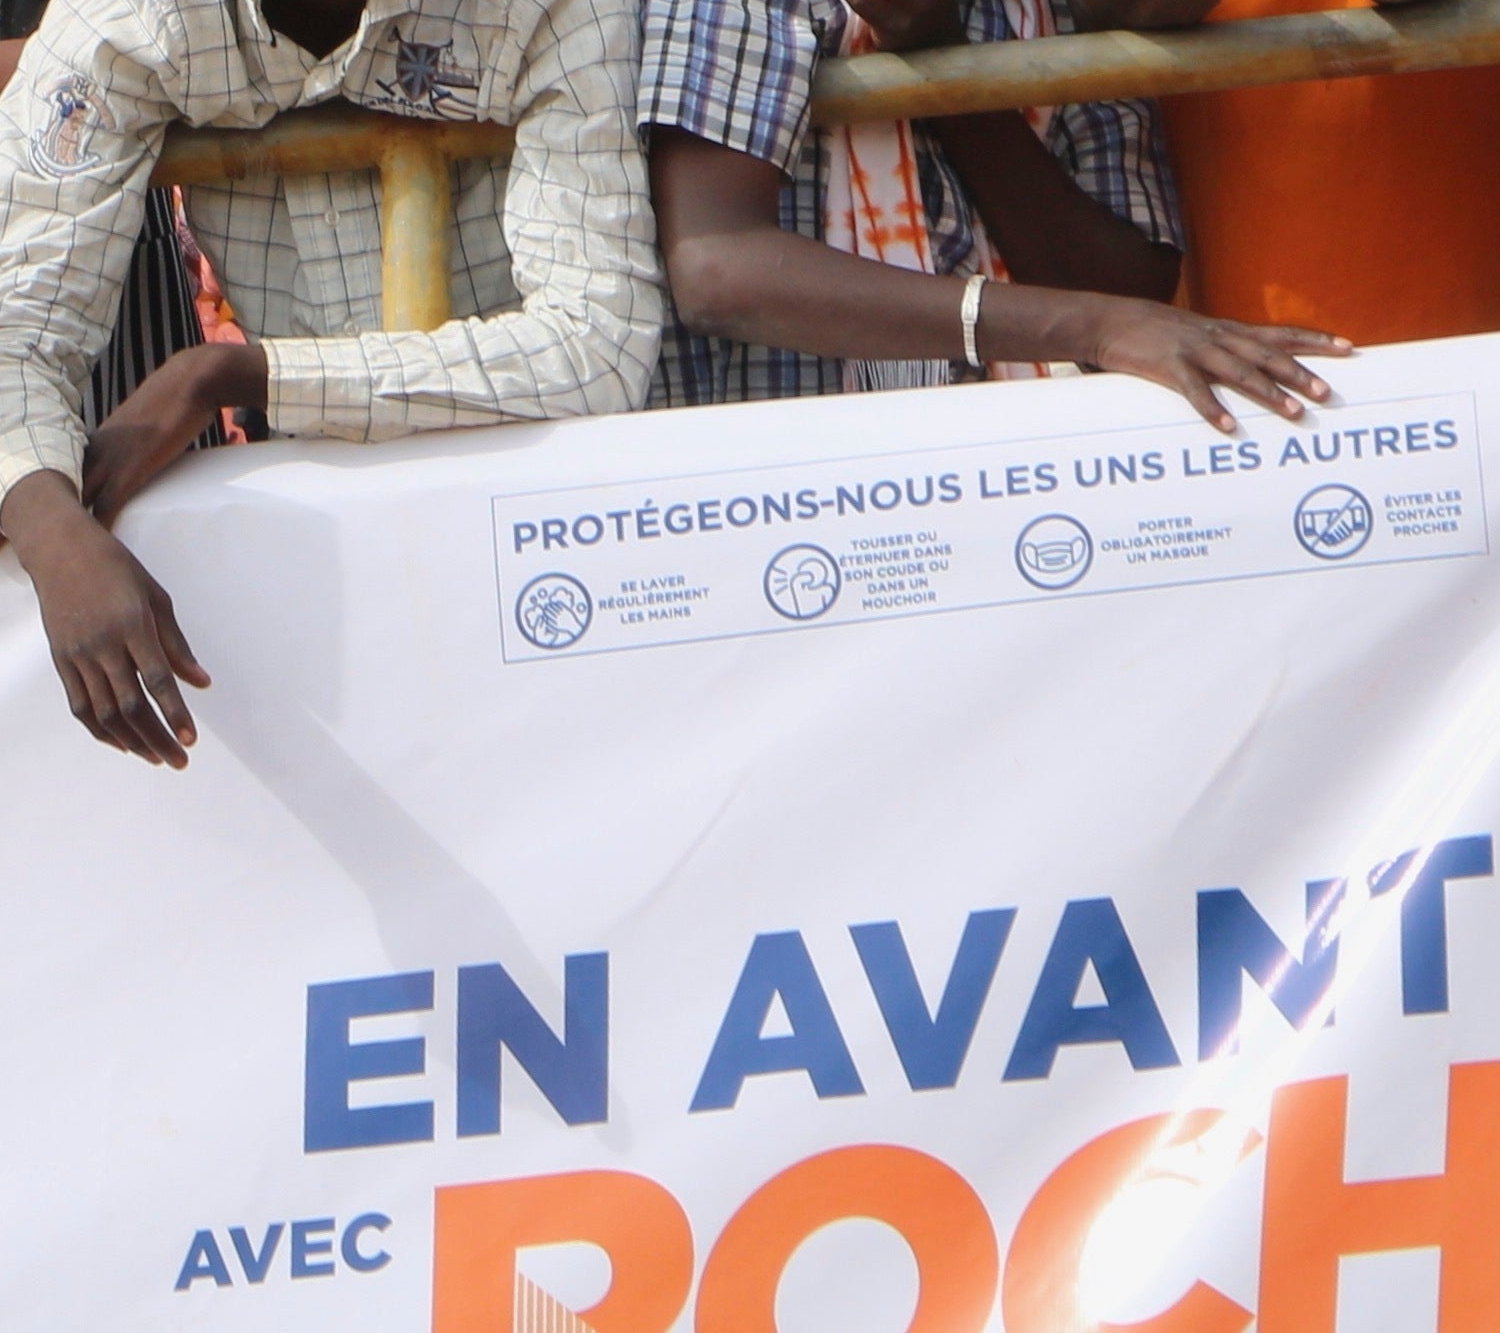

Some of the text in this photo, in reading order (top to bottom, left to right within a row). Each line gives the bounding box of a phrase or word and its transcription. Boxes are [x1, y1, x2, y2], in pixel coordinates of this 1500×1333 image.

[511, 418, 1460, 554] PROTÉGEONS-NOUS LES UNS LES AUTRES
[1383, 489, 1463, 509] ÉVITER LES
[1386, 504, 1463, 523] CONTACTS
[1136, 516, 1194, 533] PORTER
[1393, 520, 1460, 538] PROCHES
[850, 531, 939, 552] TOUSSER OU
[1100, 526, 1233, 553] OBLIGATOIREMENT
[839, 543, 953, 568] ÉTERNUER DANS
[1126, 544, 1210, 565] UN MASQUE
[843, 559, 950, 582] SON COUDE OU
[619, 574, 686, 593] SE LAVER
[866, 576, 930, 595] DANS UN
[862, 590, 937, 611] MOUCHOIR
[619, 606, 692, 625] LES MAINS
[303, 833, 1494, 1155] EN AVANT
[173, 1210, 393, 1293] AVEC
